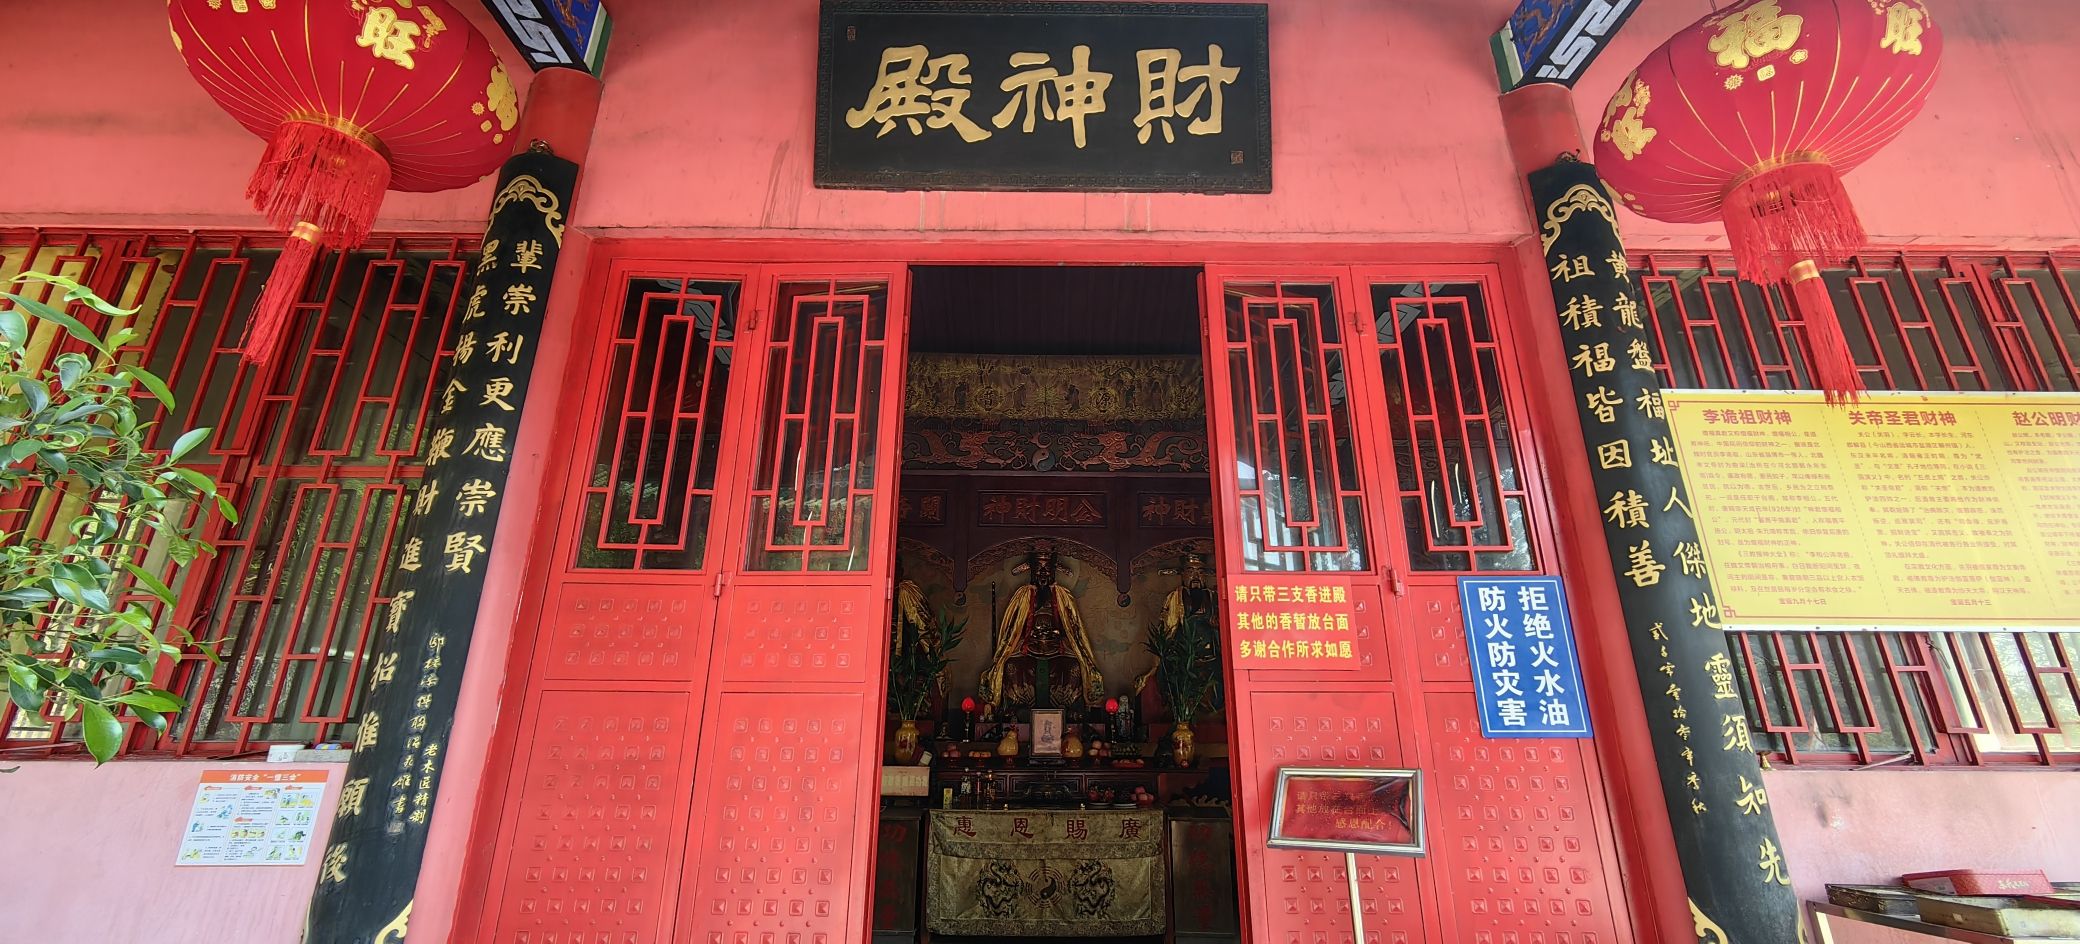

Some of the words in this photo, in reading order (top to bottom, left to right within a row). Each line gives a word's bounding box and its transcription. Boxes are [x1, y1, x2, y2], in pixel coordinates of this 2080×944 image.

[1702, 409, 1793, 425] 李诡祖财神
[1848, 410, 1958, 427] 关帝圣君财神
[1234, 585, 1347, 604] 请只带三支香进殿
[1236, 612, 1349, 632] 其他的香暂放台面
[1239, 640, 1353, 660] 多谢合作所求如愿
[1477, 586, 1528, 727] 防火防灾害
[1517, 586, 1571, 727] 拒绝火水油
